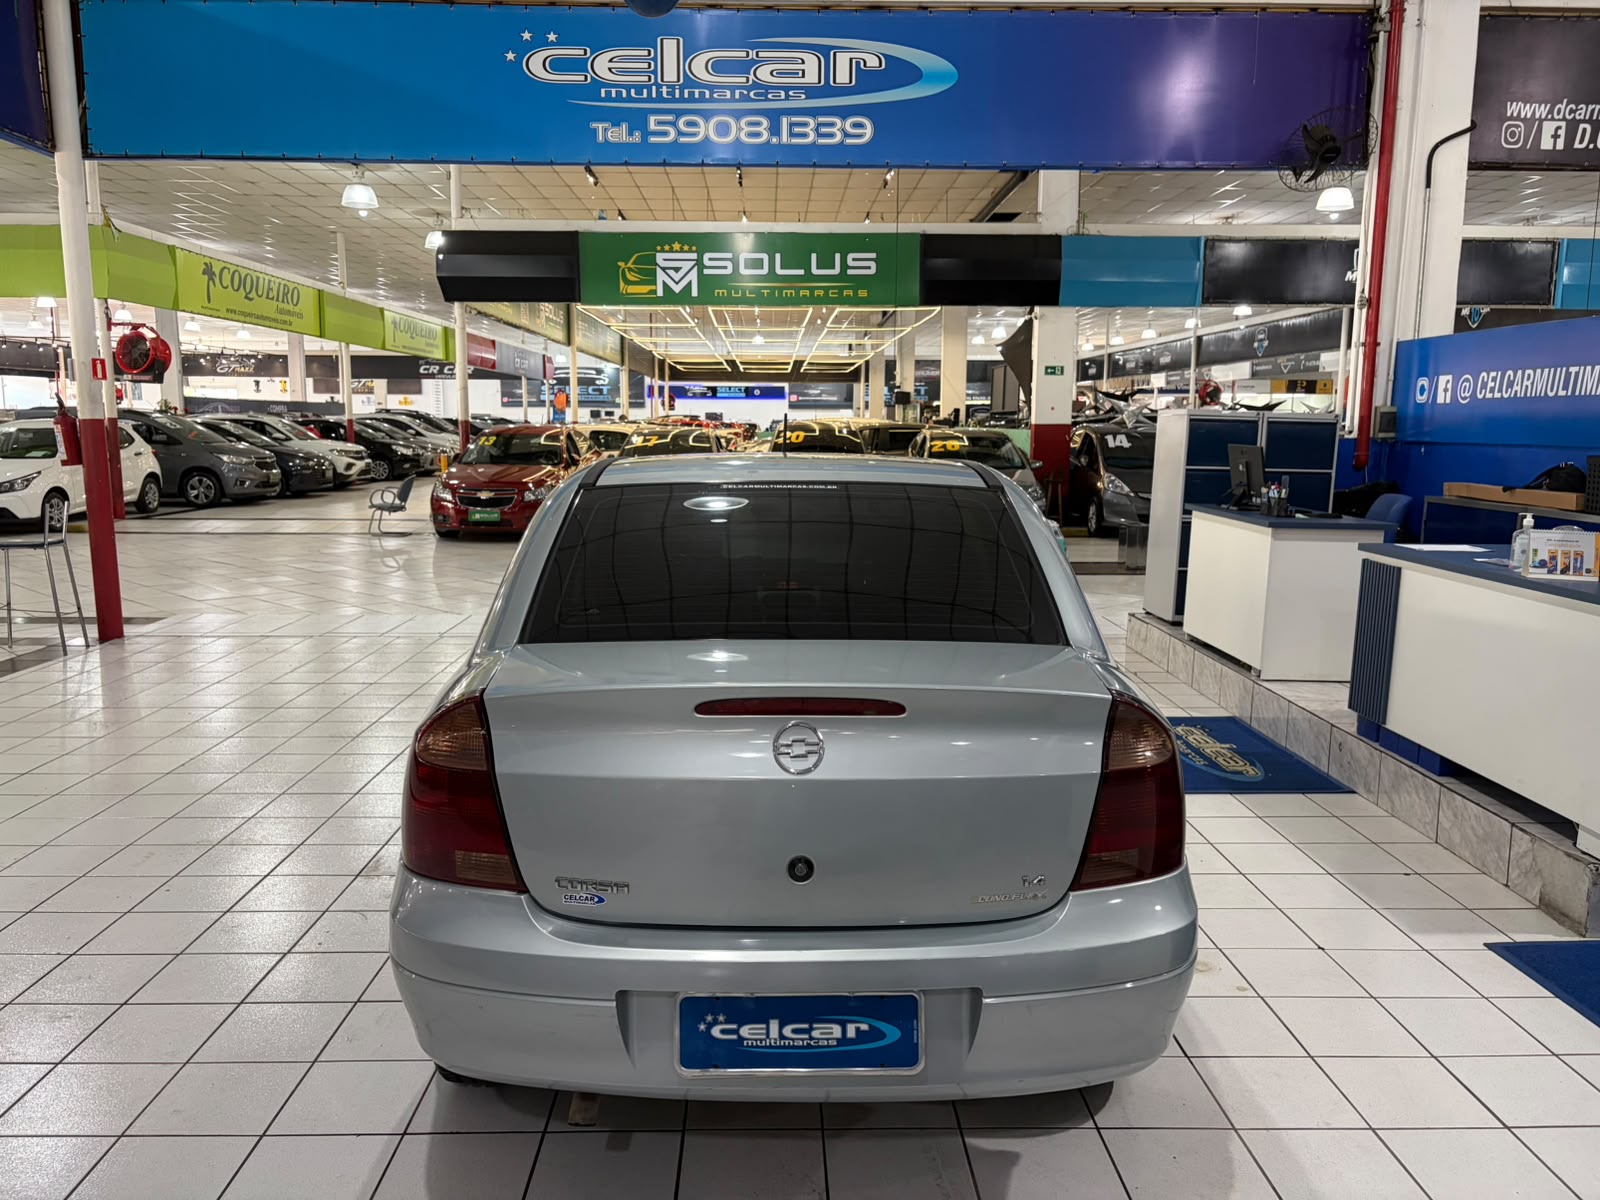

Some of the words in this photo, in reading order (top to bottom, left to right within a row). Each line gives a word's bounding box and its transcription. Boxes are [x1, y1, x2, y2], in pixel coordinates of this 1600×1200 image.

[522, 36, 886, 87] celcar
[600, 85, 806, 101] multimarcas
[648, 114, 875, 145] 5908.1339
[703, 252, 877, 275] SOLUS
[218, 266, 301, 307] COQUEIRO
[714, 289, 868, 297] MULTIMARCAS
[1476, 365, 1600, 400] CELCARMULTIM
[1104, 434, 1132, 448] 14
[555, 876, 630, 895] CORSA
[564, 894, 596, 903] CELCAR
[710, 1019, 870, 1040] celcar
[743, 1038, 838, 1048] multimarcas
